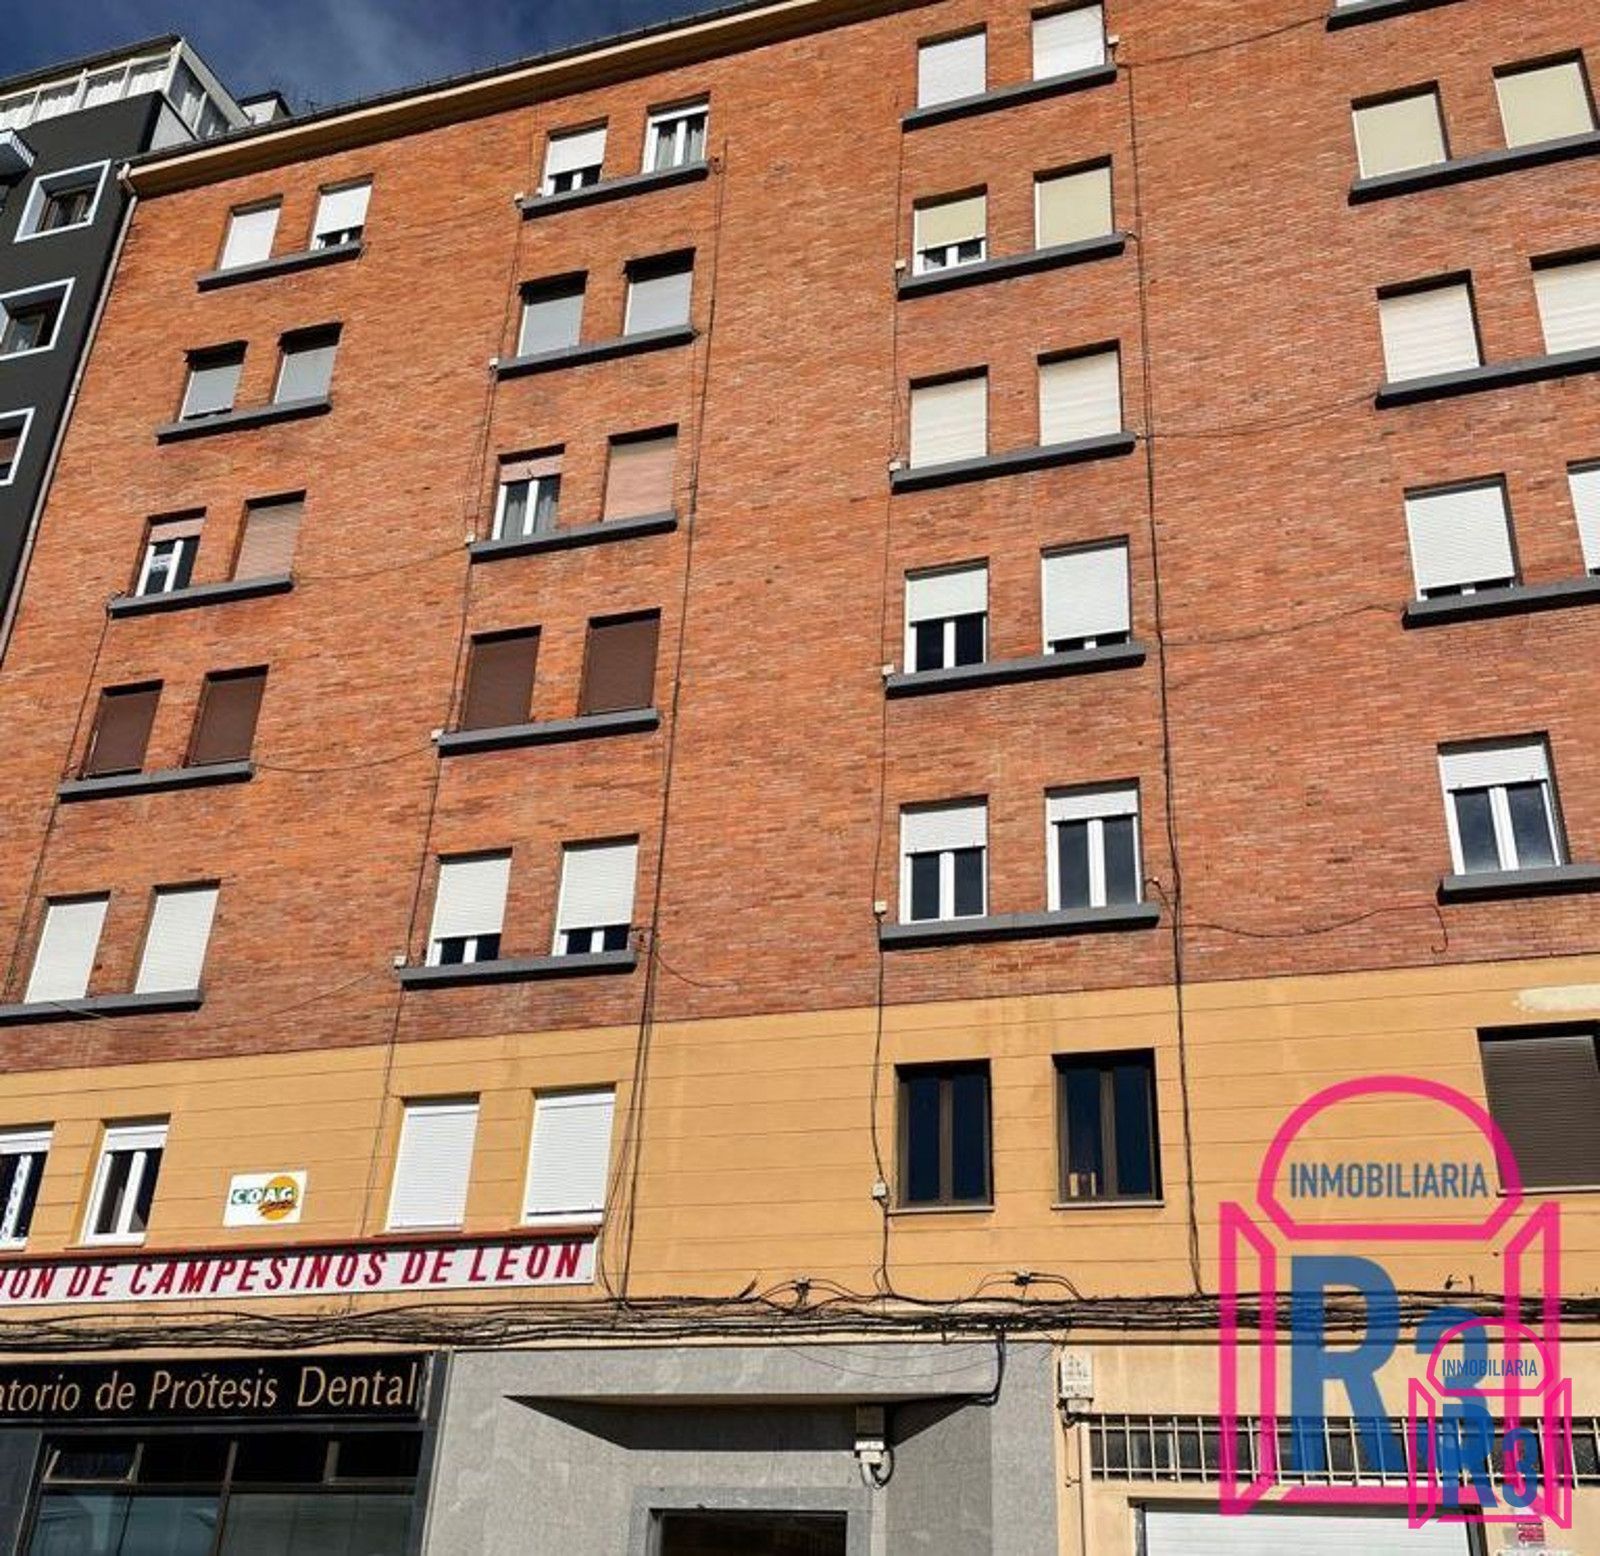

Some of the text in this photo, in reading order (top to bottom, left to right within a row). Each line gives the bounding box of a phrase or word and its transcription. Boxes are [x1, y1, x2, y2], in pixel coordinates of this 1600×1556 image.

[231, 1187, 295, 1205] COAG
[66, 1263, 117, 1297] DE
[129, 1250, 387, 1294] CAMPESINOS
[401, 1247, 457, 1284] DE
[468, 1242, 582, 1282] LEON
[95, 1370, 136, 1411] de
[148, 1368, 278, 1409] Prótesis
[297, 1362, 418, 1407] Dental
